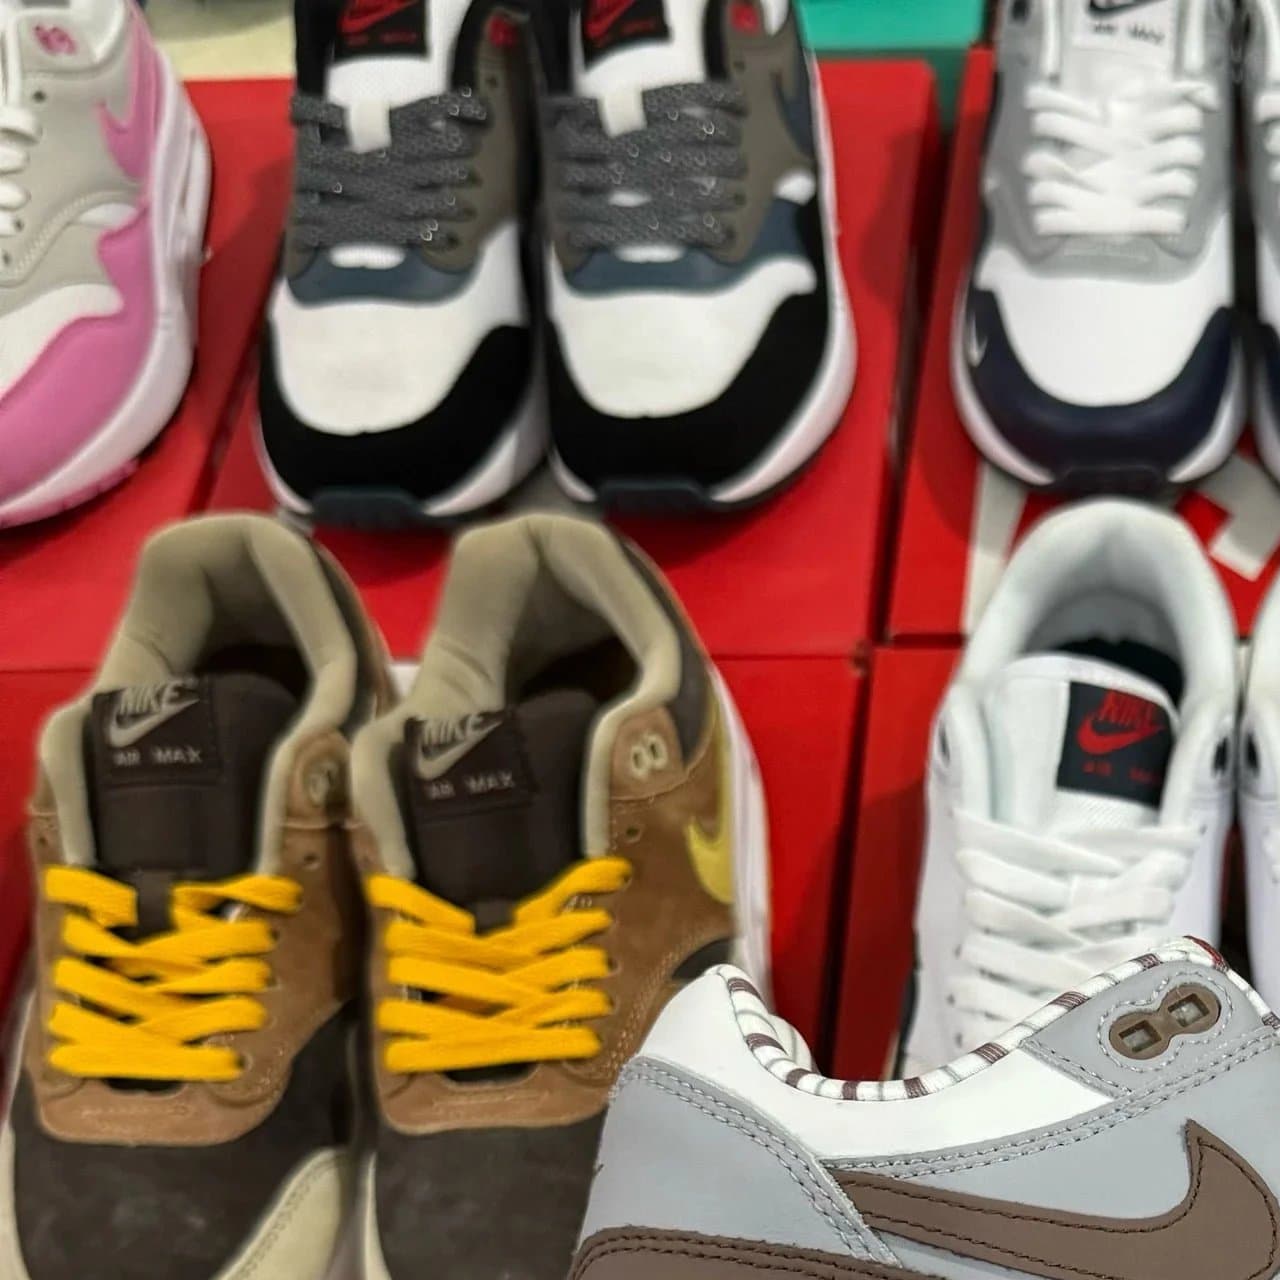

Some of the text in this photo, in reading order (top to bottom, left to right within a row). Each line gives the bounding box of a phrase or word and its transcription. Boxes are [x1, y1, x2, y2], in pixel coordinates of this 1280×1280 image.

[119, 681, 184, 714] NIKE
[424, 714, 484, 745] NIKE
[153, 745, 202, 764] MAX
[464, 770, 516, 795] MAX
